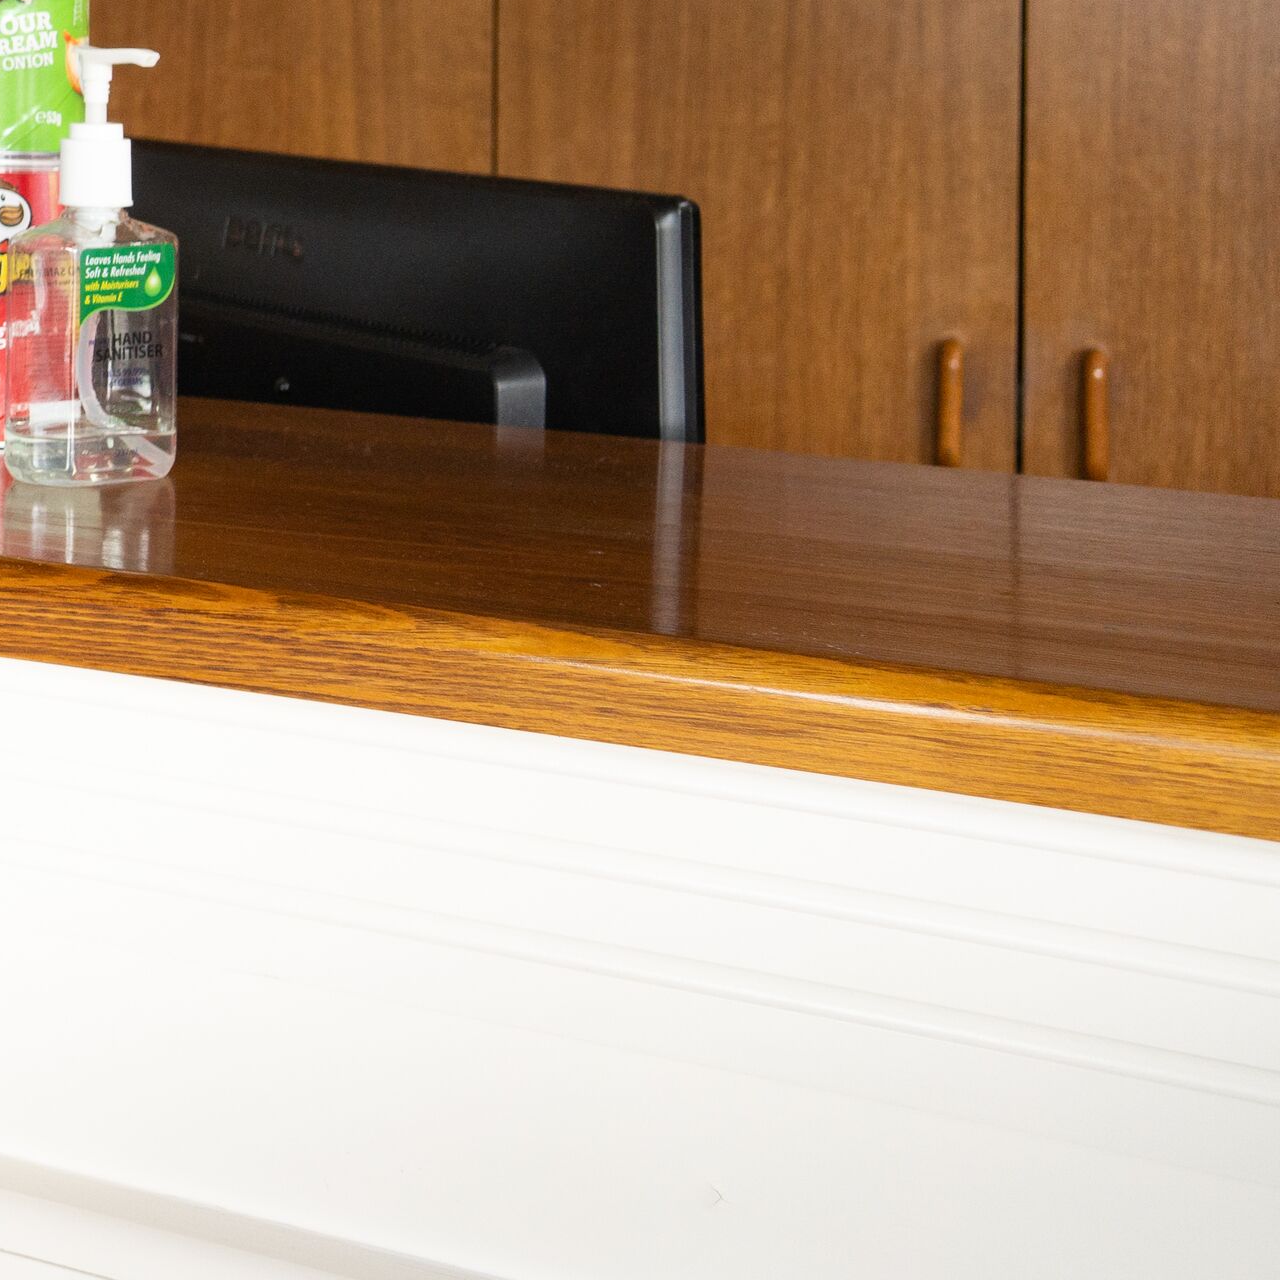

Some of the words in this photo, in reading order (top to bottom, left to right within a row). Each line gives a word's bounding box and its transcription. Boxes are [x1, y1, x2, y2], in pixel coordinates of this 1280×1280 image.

[2, 51, 54, 72] ONION
[85, 254, 111, 266] Leaves
[112, 252, 135, 264] Hands
[136, 250, 161, 264] Feeling
[85, 265, 101, 279] Soft
[102, 267, 109, 278] &
[110, 263, 147, 276] Refreshed
[84, 281, 100, 292] with
[117, 291, 123, 302] E
[112, 331, 152, 346] HAND
[95, 344, 163, 363] SANITISER
